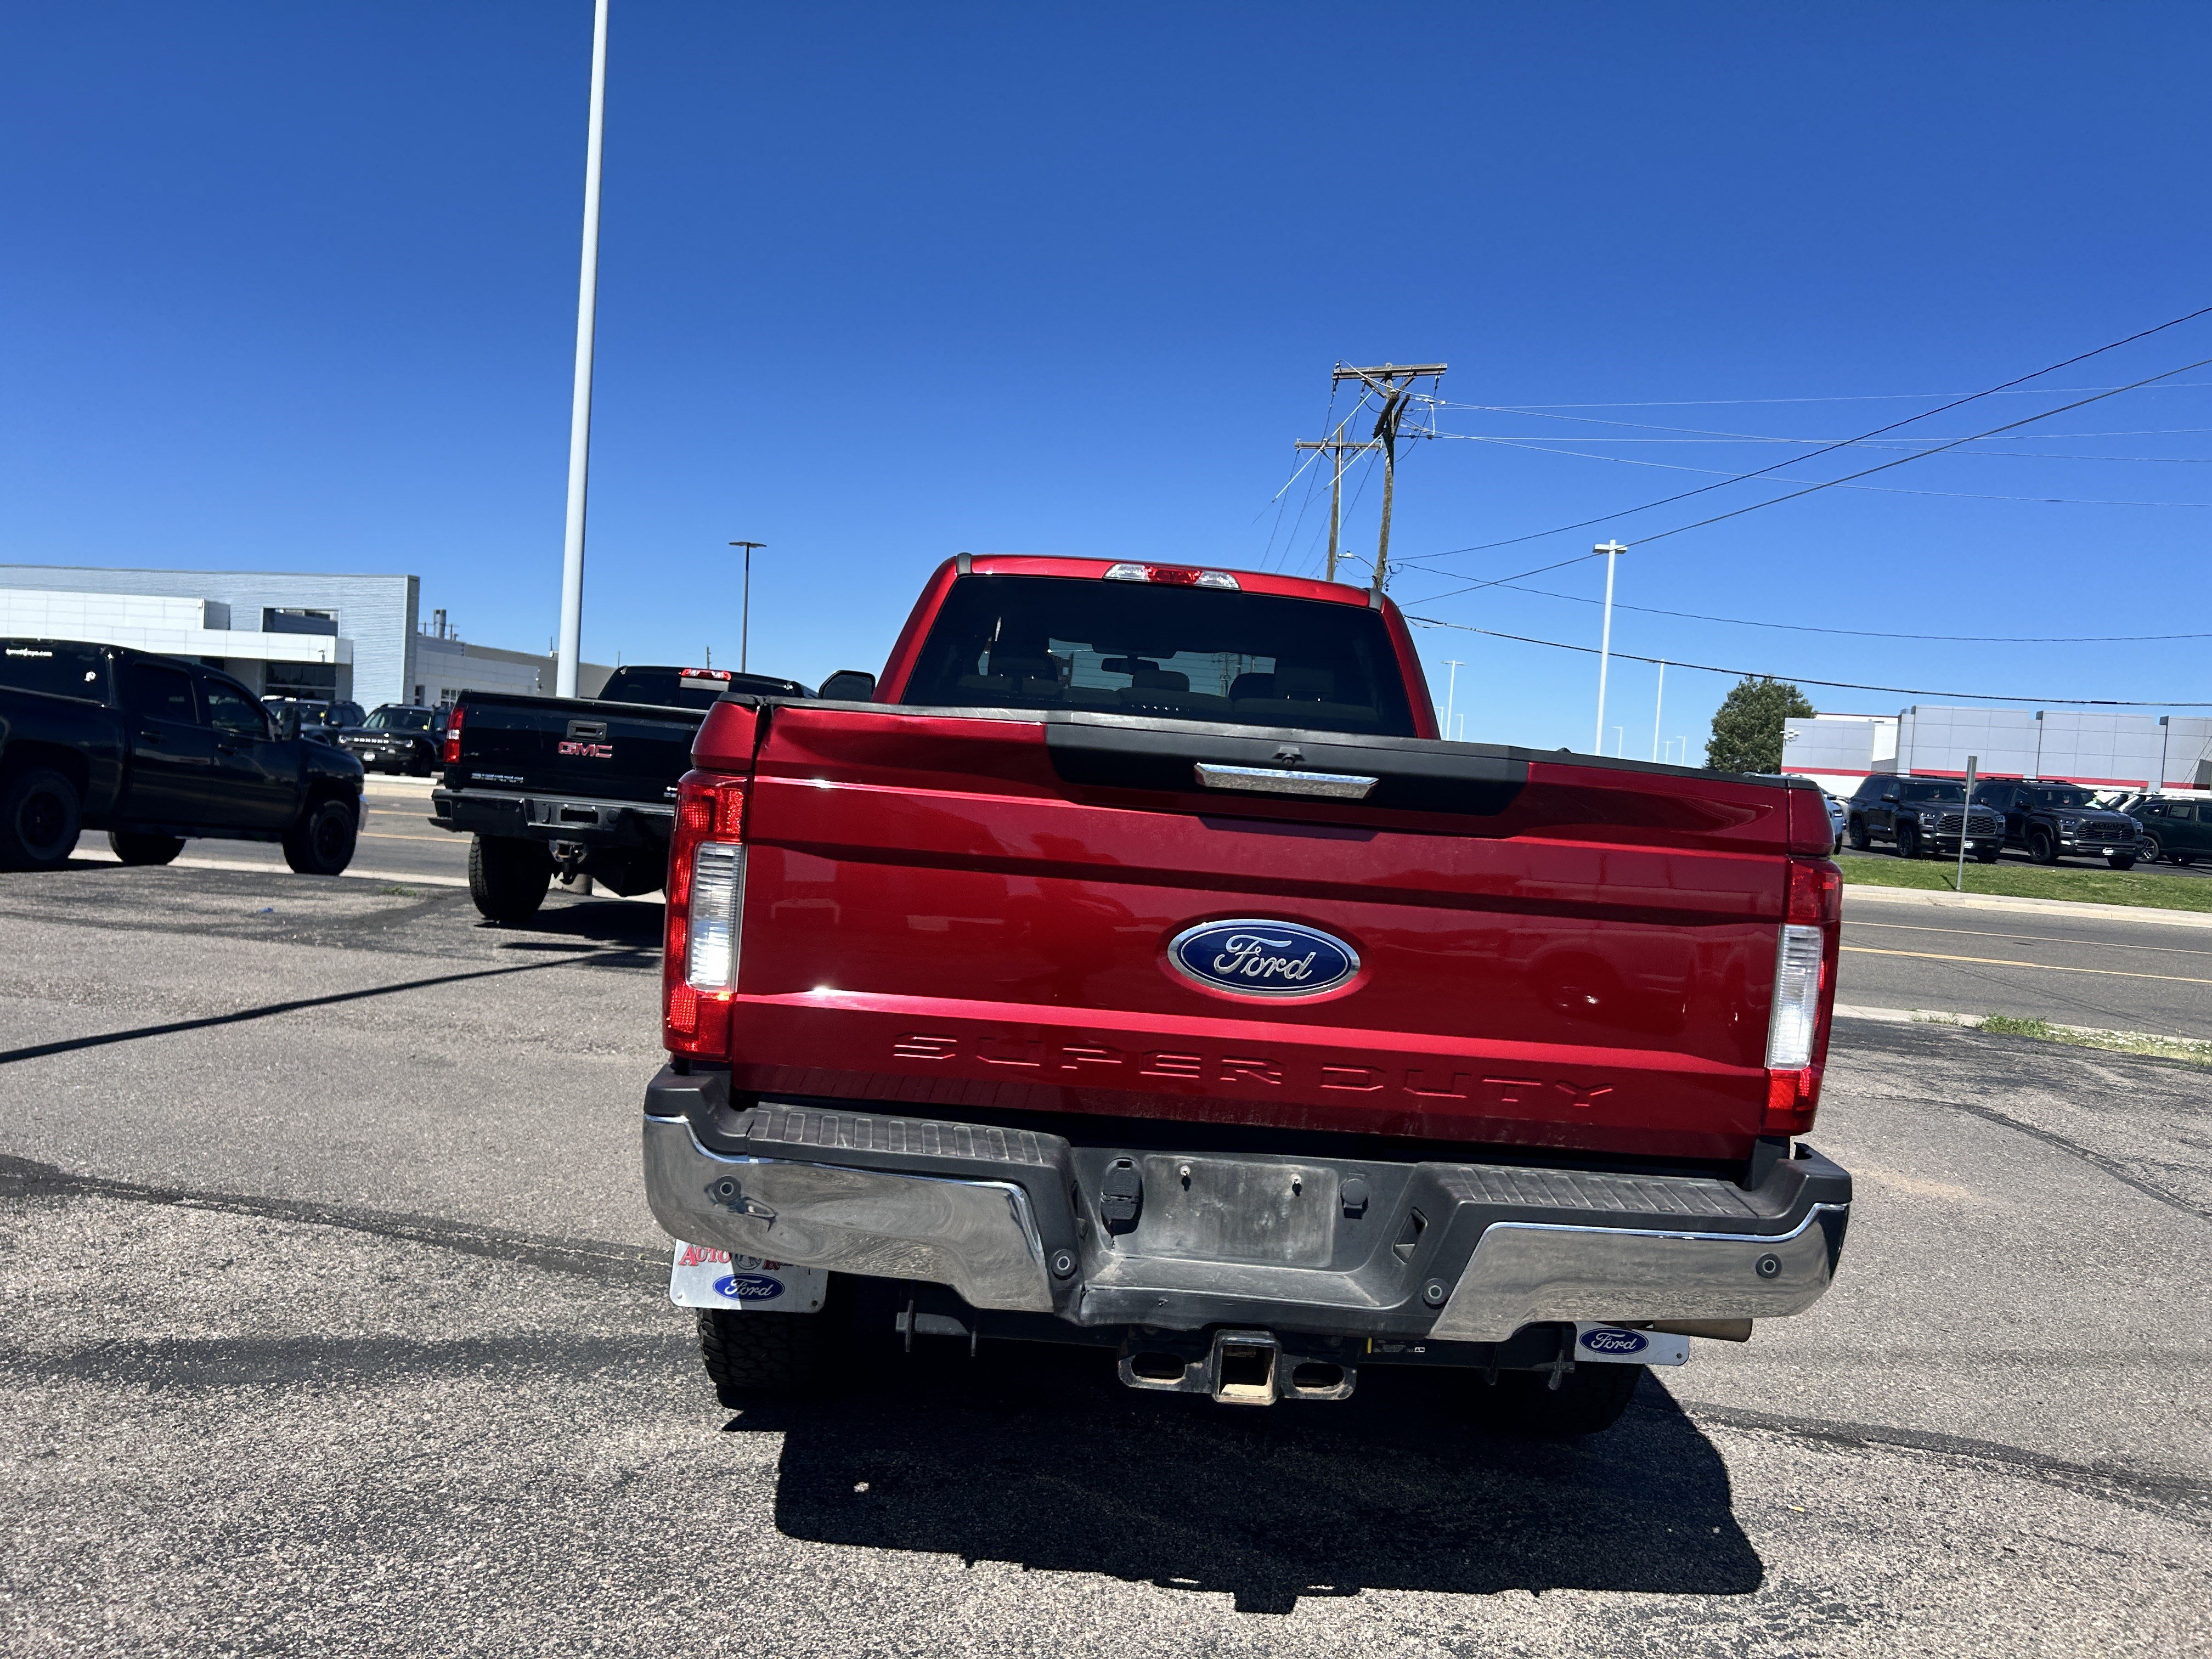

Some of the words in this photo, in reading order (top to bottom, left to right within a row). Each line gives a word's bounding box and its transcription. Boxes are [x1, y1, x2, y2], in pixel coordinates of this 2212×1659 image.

[558, 741, 613, 758] GMC
[471, 772, 523, 783] SIERRA
[1214, 934, 1317, 980] Ford
[893, 1031, 1285, 1085] SUPER
[1319, 1063, 1615, 1107] DUTY
[724, 1278, 774, 1296] Ford
[1591, 1333, 1638, 1350] Ford
